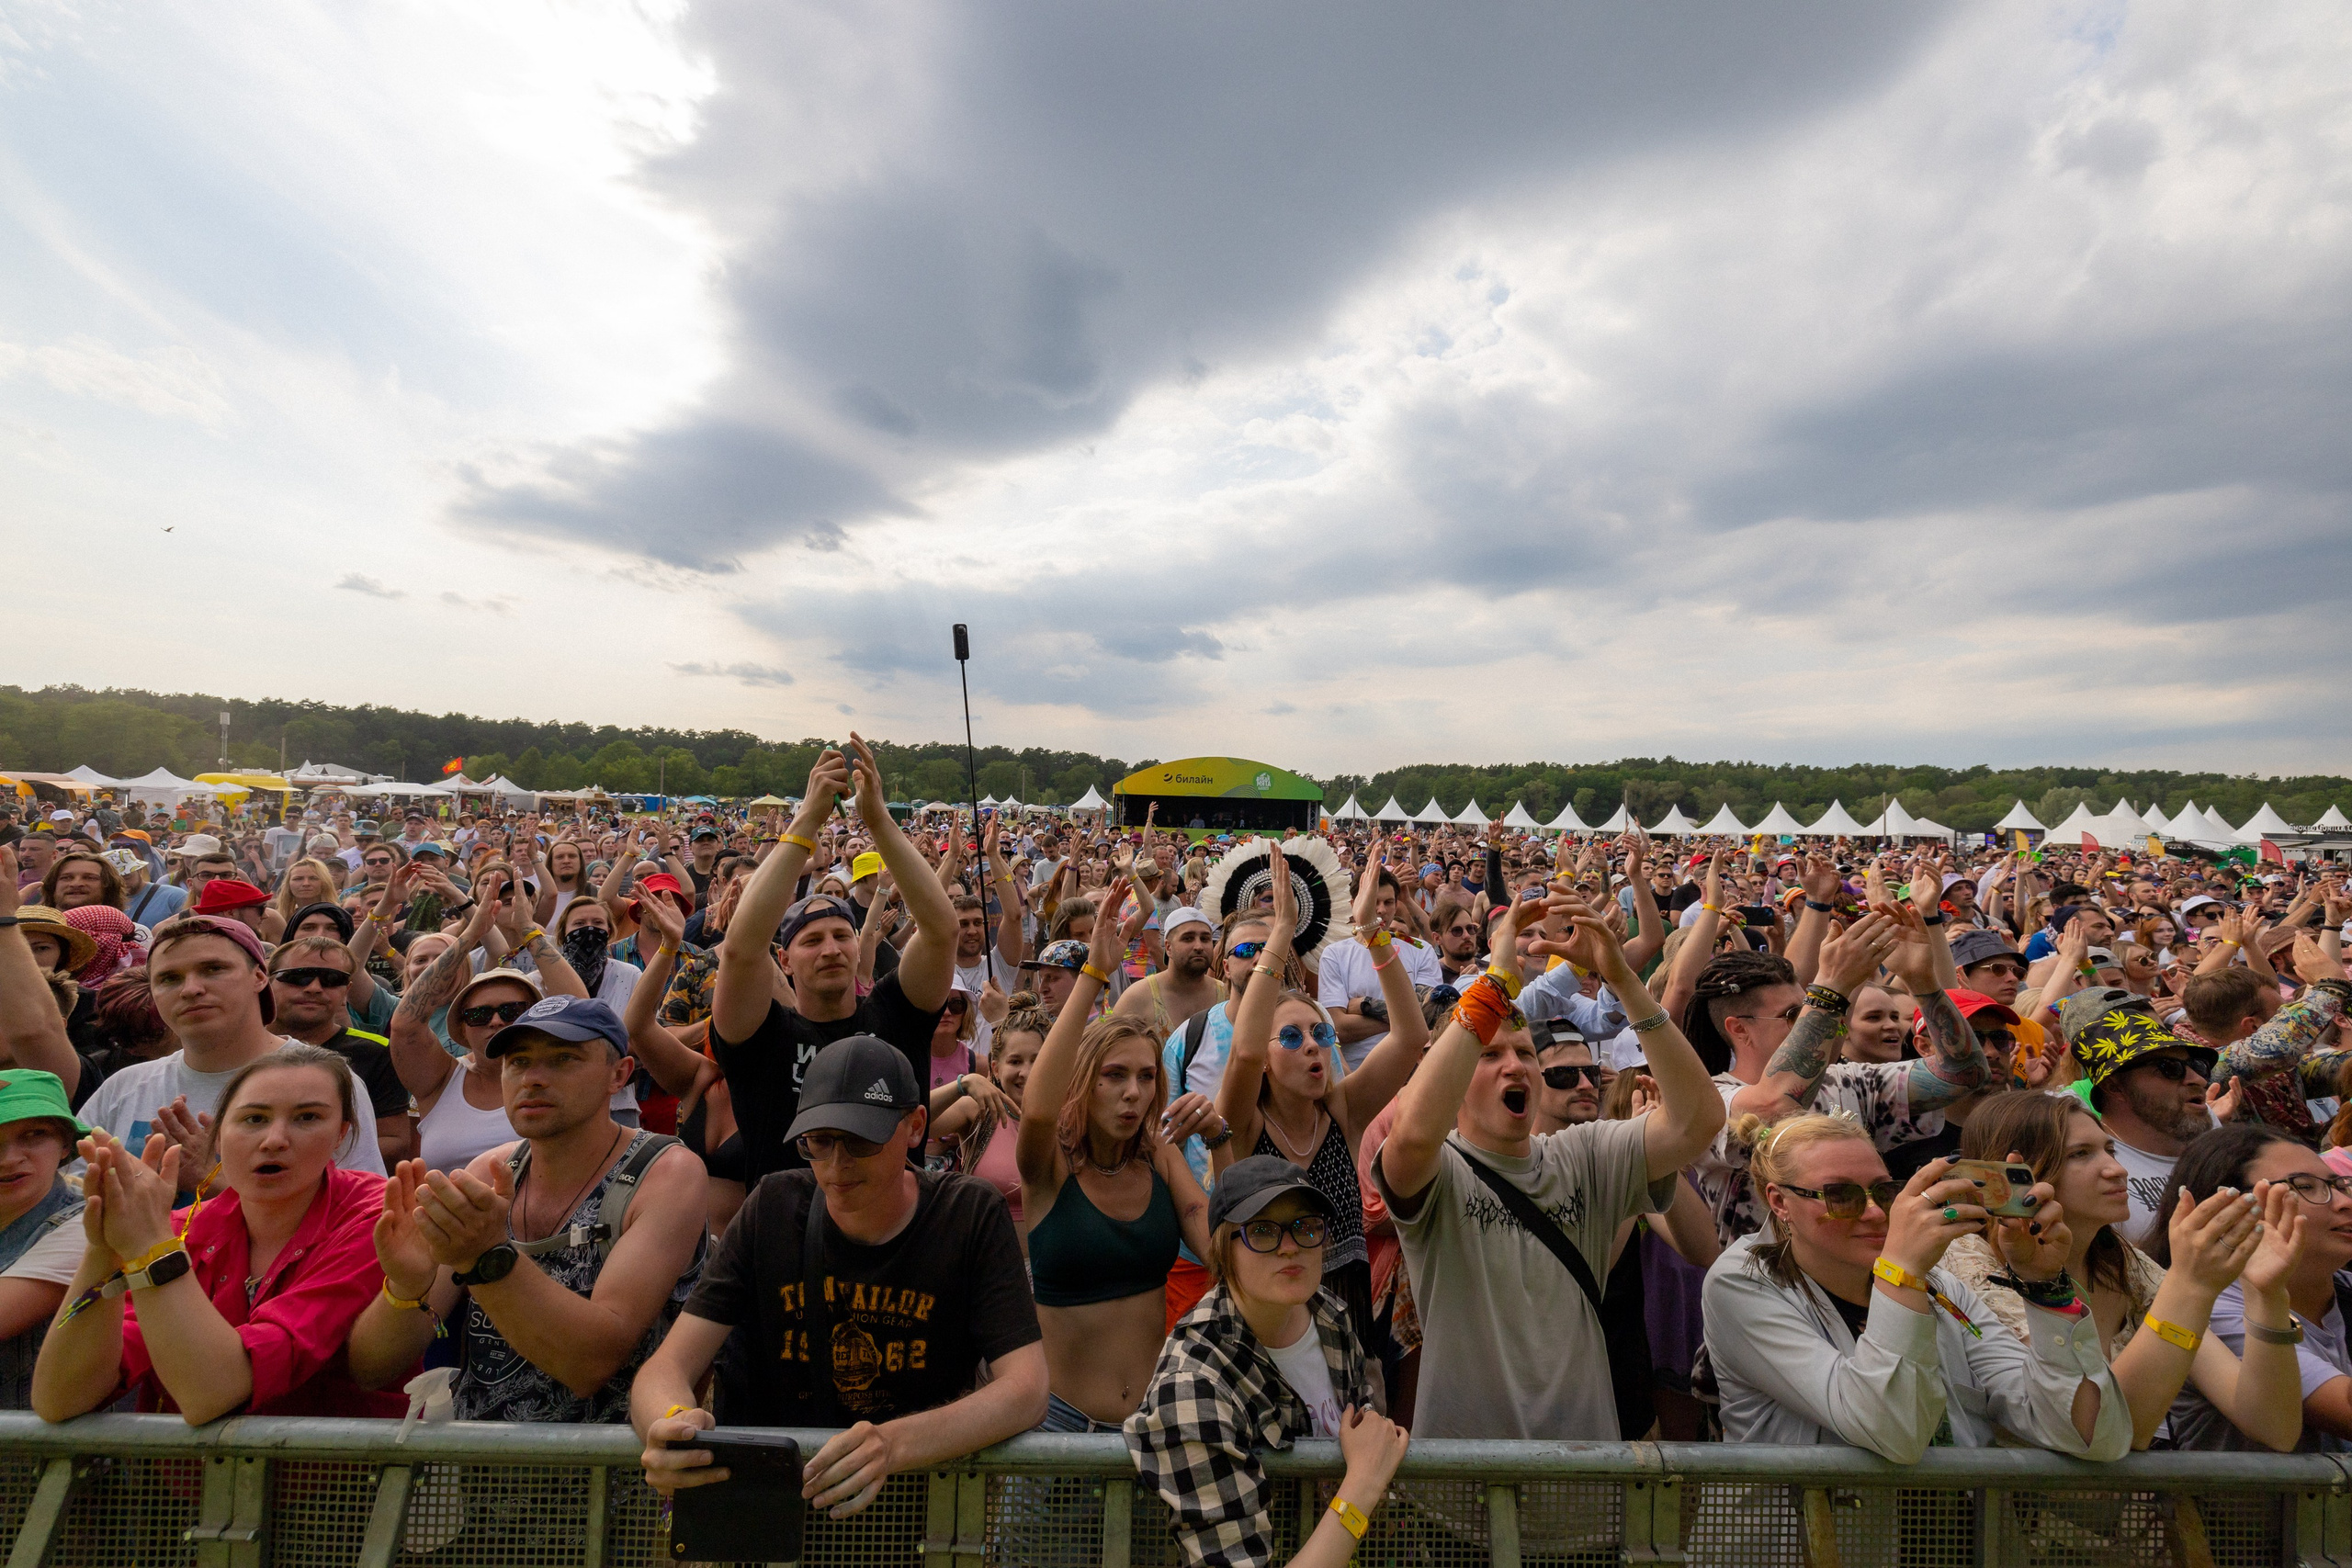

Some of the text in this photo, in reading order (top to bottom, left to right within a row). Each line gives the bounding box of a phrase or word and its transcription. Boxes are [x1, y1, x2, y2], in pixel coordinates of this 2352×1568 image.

[1175, 773, 1213, 784] билайн
[2289, 823, 2316, 831] SMOKED
[2317, 823, 2346, 832] GORILLA
[864, 1091, 893, 1102] adidas
[469, 1311, 496, 1329] SU
[882, 1314, 914, 1328] GEAR
[885, 1339, 927, 1371] 62
